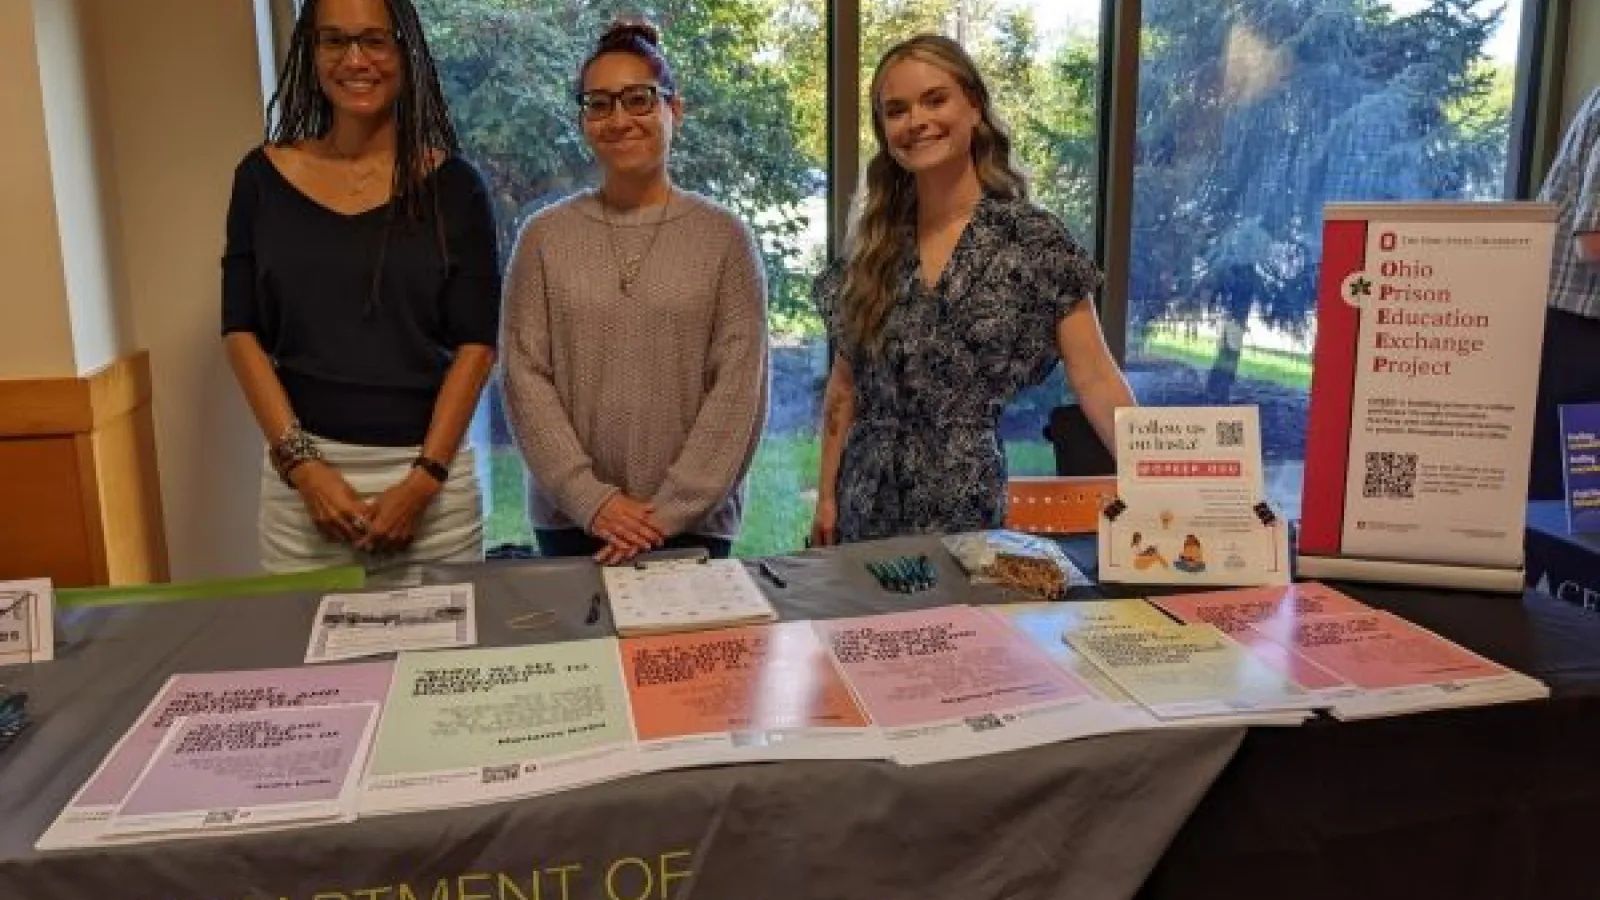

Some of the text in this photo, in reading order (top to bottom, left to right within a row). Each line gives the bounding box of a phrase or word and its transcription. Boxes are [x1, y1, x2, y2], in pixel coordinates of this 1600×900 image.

[1381, 260, 1433, 278] Ohio
[1378, 284, 1450, 301] Prison
[1376, 308, 1489, 328] Education
[1375, 331, 1484, 356] Exchange
[1372, 356, 1452, 379] Project
[1128, 419, 1182, 434] Follow
[605, 850, 695, 900] OF
